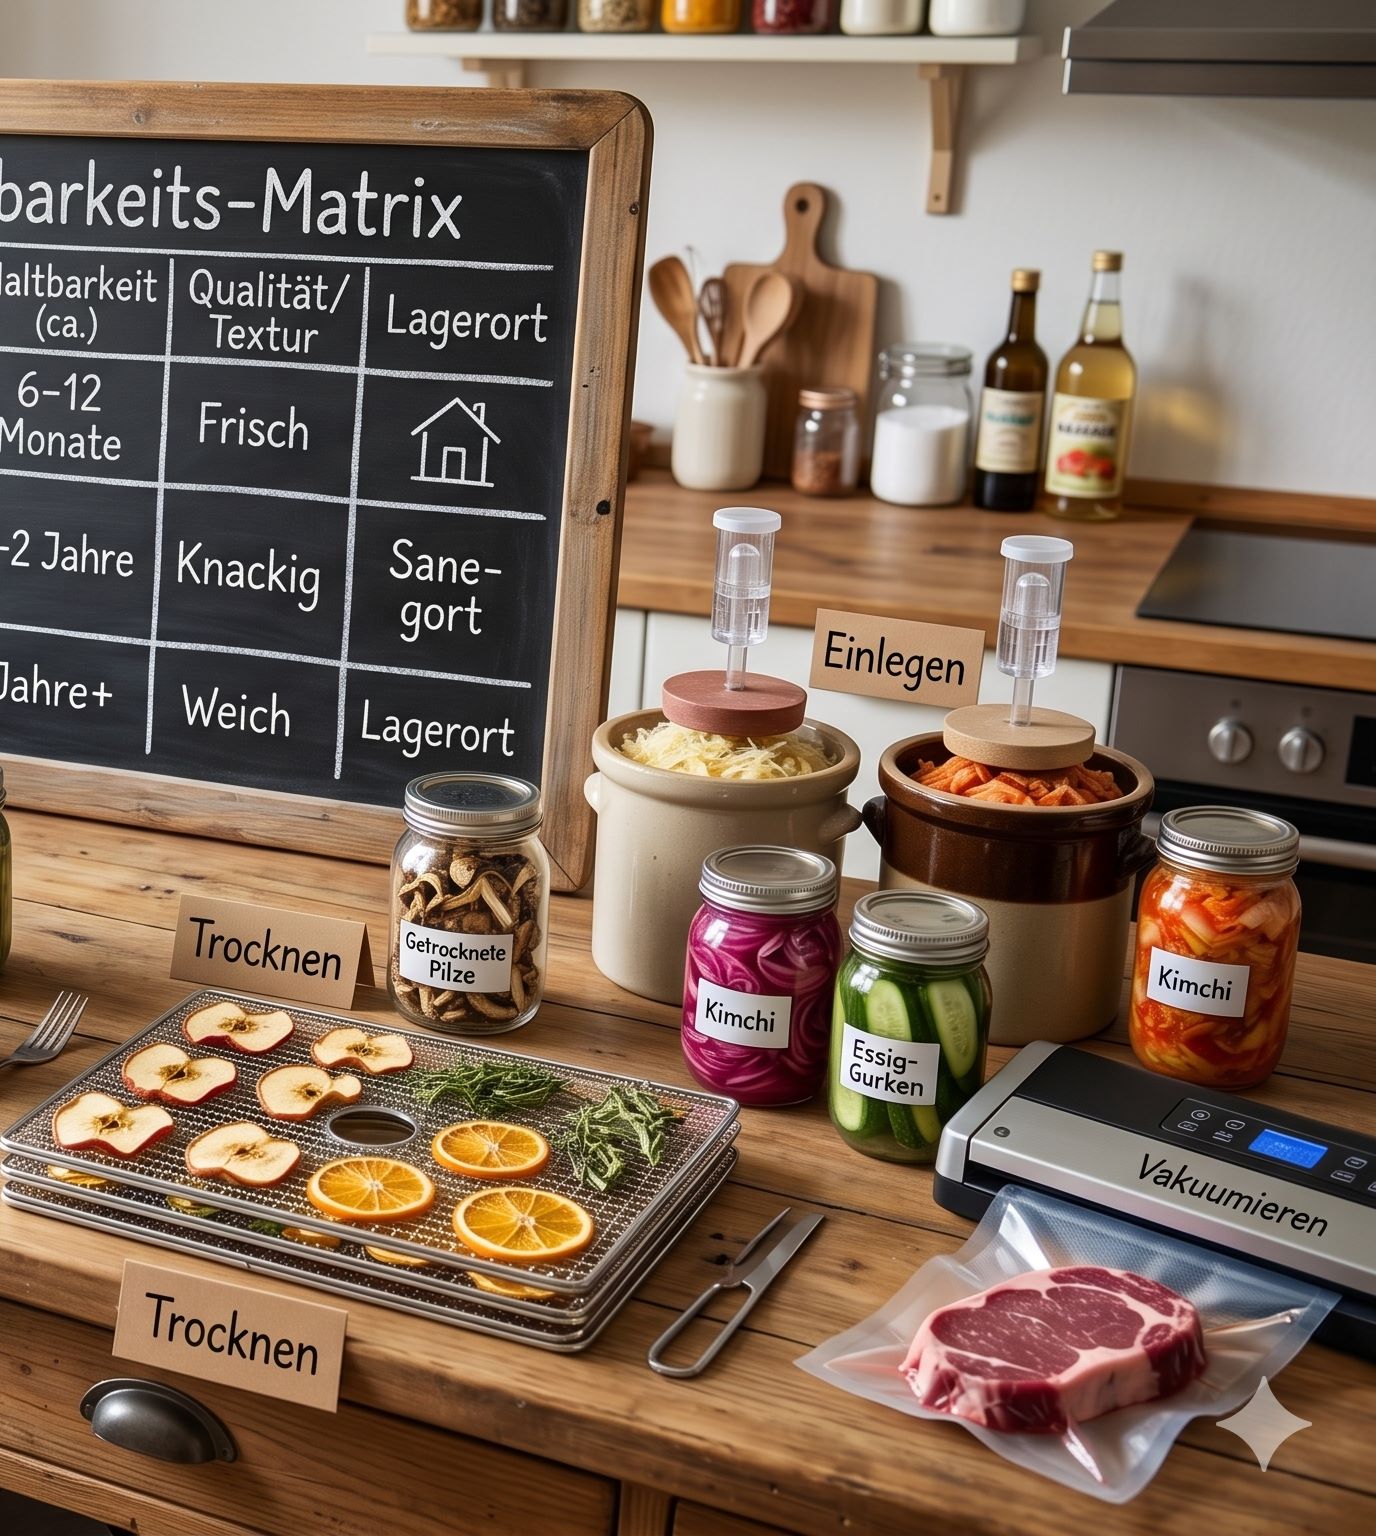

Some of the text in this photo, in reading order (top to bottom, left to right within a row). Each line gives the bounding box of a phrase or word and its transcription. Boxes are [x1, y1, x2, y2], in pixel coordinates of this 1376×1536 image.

[188, 268, 351, 315] Qualität/
[34, 304, 99, 346] (ca.)
[212, 315, 319, 354] Textur
[387, 293, 548, 350] Lagerort
[199, 401, 309, 451] Frisch
[40, 530, 135, 578] Jahre
[177, 540, 321, 612] Knackig
[389, 538, 503, 586] Sane-
[399, 595, 483, 643] gort
[824, 630, 965, 692] Einlegen
[181, 684, 291, 738] Weich
[361, 698, 516, 760] Lagerort
[189, 916, 342, 981] Trocknen
[405, 931, 507, 962] Getrocknete
[429, 959, 476, 985] Pilze
[1157, 966, 1232, 1002] Kimchi
[705, 998, 776, 1034] Kimchi
[852, 1038, 919, 1074] Essig-
[849, 1064, 924, 1098] Gurken
[1138, 1153, 1329, 1238] Vakuumieren
[145, 1291, 318, 1376] Trocknen
